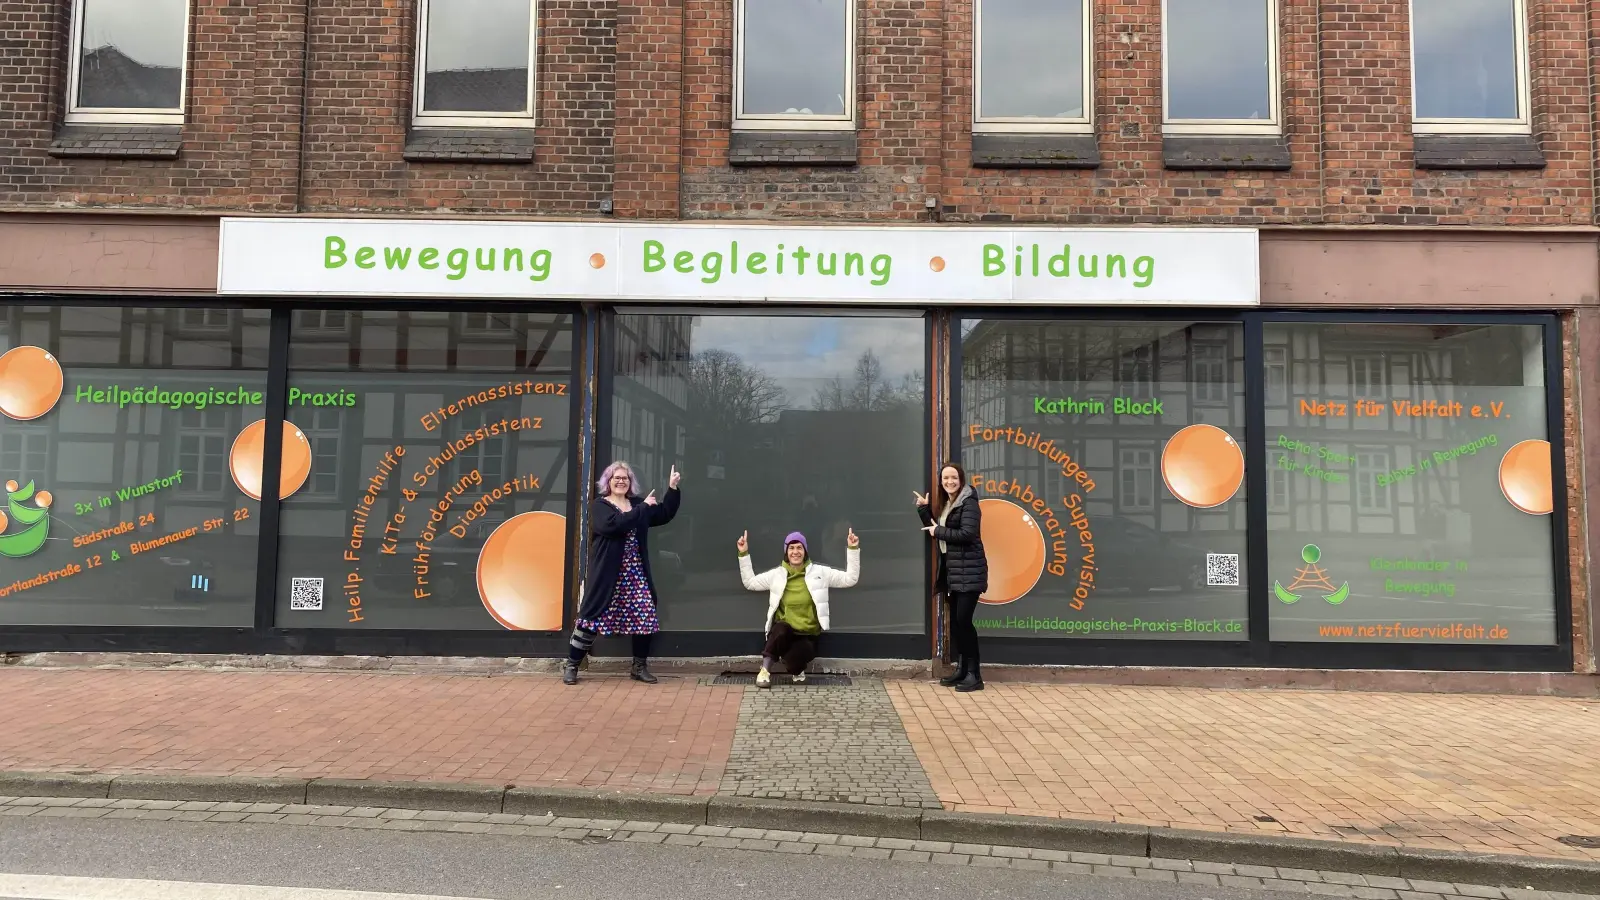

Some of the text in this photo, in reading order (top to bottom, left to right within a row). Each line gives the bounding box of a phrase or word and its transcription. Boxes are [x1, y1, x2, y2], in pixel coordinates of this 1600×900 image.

[323, 235, 1156, 288] Bewegung Begleitung Bildung
[75, 384, 357, 410] Heilpädagogische Praxis
[420, 380, 567, 432] Elternassistenz
[1034, 396, 1164, 415] Kathrin Block
[1300, 399, 1512, 418] Netz für Vielfalt e.V.
[969, 424, 1096, 493] Fortbildungen
[1278, 455, 1298, 471] für
[1420, 458, 1431, 470] in
[1433, 433, 1497, 464] Bewegung
[74, 469, 183, 516] 3x in Wunstorf
[380, 416, 542, 554] KiTa- & Schulassistenz
[449, 474, 541, 539] Diagnostik
[73, 512, 155, 548] Südstraße 24
[343, 445, 406, 622] Heilp. Familienhilfe
[413, 469, 483, 599] Frühförderung
[971, 475, 1068, 576] Fachberatung
[0, 507, 250, 597] ortlandstraße 12 & Blumenauer Str. 22
[1064, 493, 1099, 611] Supervision
[1385, 578, 1456, 598] Bewegung
[1319, 623, 1508, 639] www.netzfuervielfalt.de
